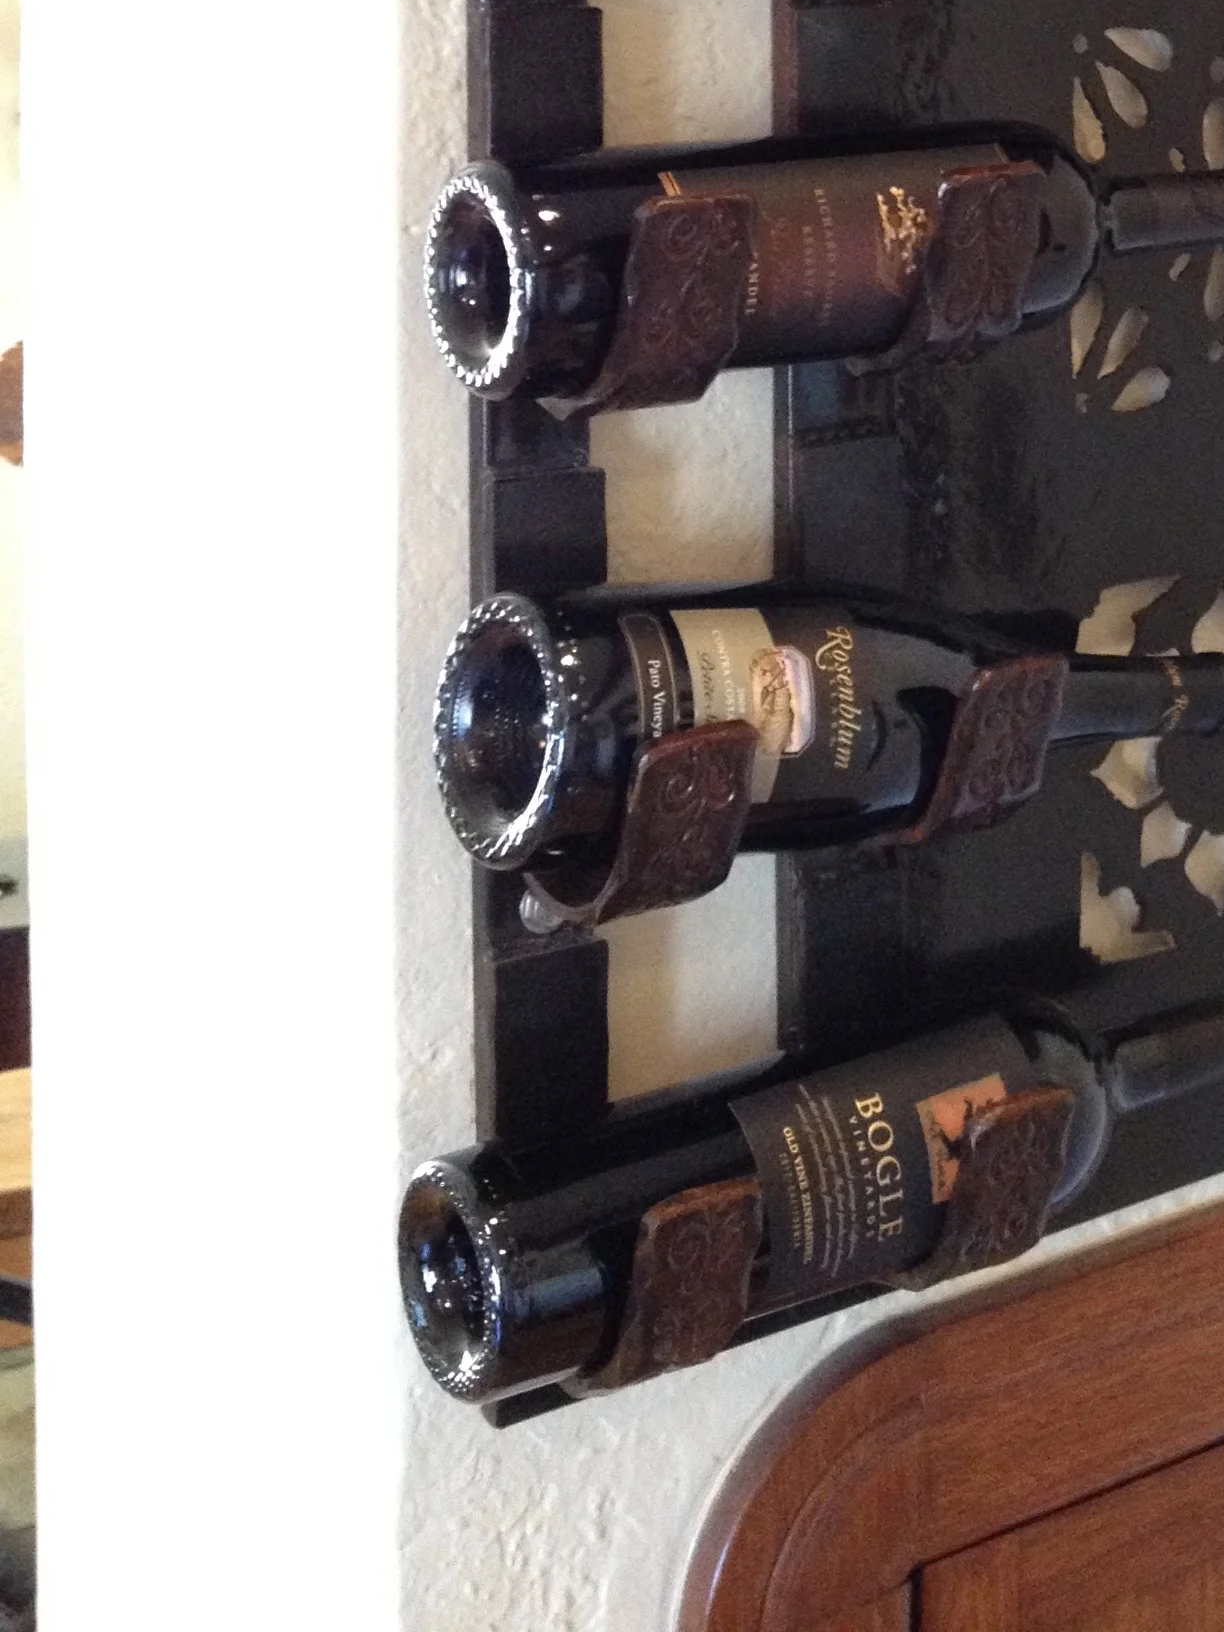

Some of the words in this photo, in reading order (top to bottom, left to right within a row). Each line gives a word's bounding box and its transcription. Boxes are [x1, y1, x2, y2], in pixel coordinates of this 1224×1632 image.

[813, 188, 836, 262] RICHARD
[744, 262, 759, 316] ANDEL
[648, 659, 661, 688] Pato
[814, 626, 863, 769] Rosenblum
[650, 690, 668, 738] Vineya
[783, 1126, 799, 1154] OLD
[794, 1155, 809, 1191] VINE
[855, 1092, 904, 1242] BOGLE
